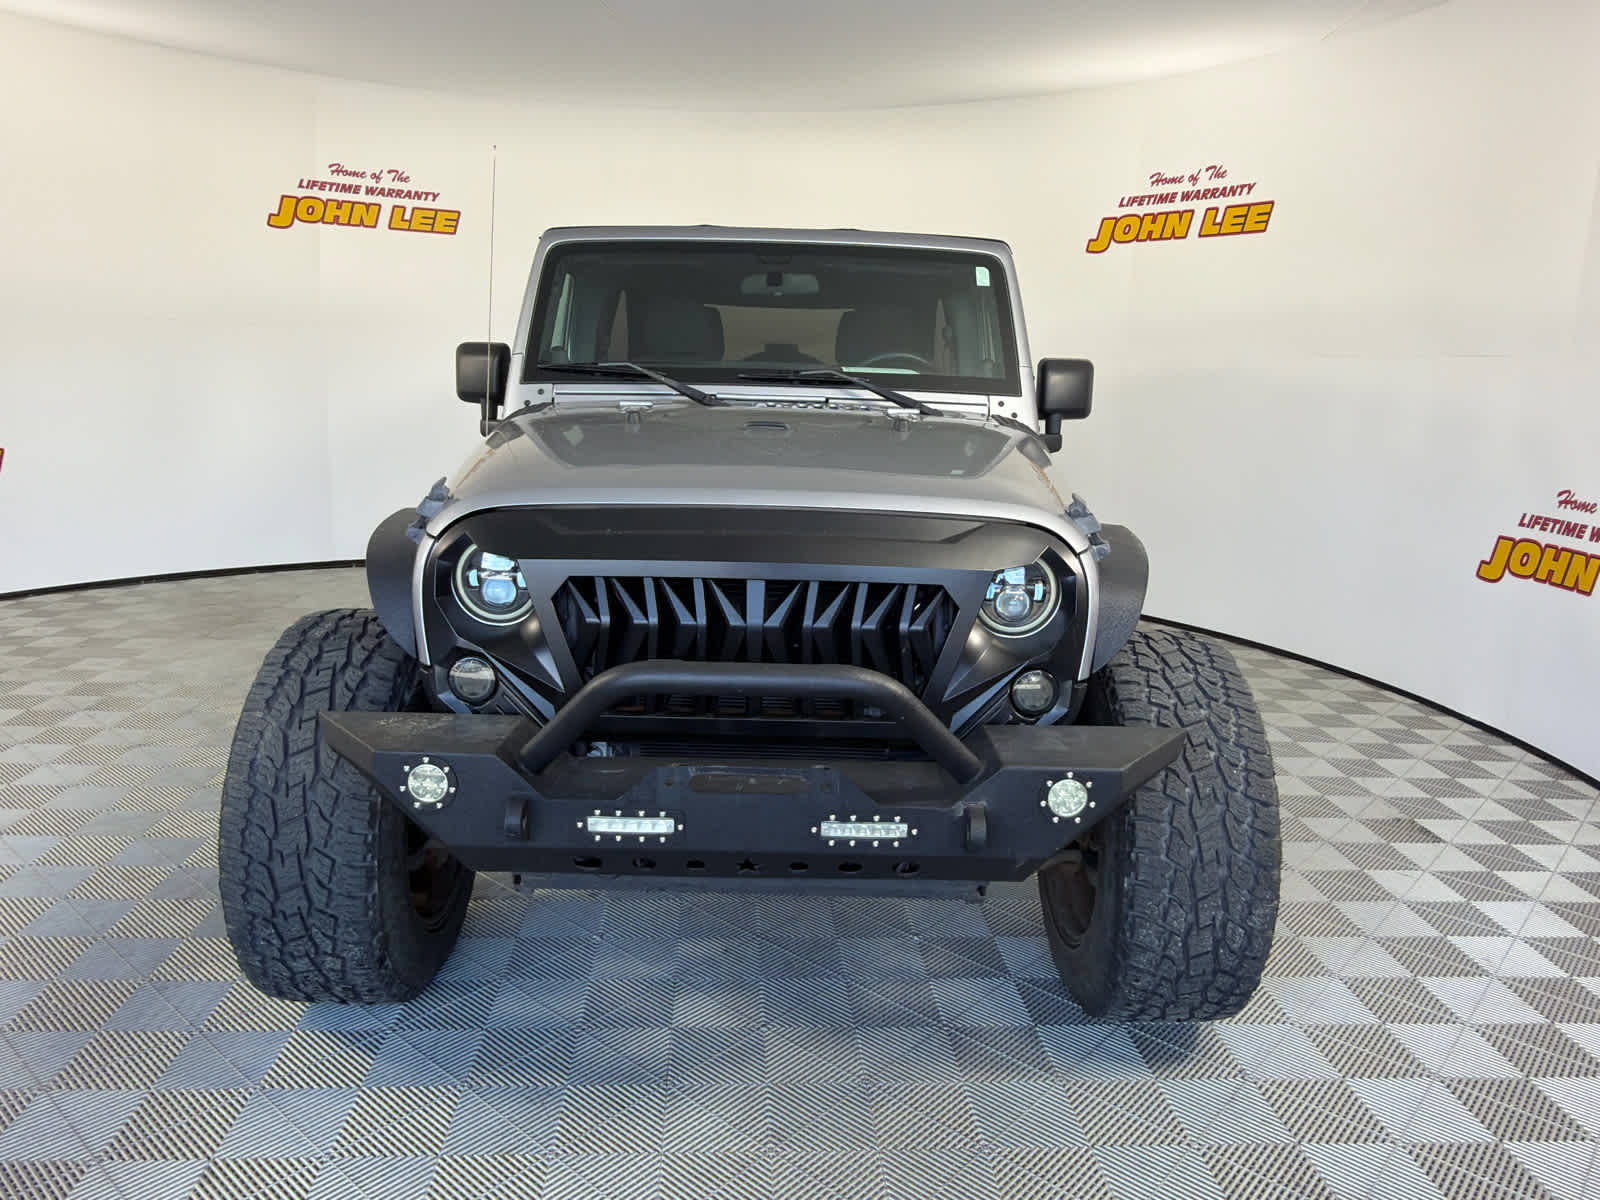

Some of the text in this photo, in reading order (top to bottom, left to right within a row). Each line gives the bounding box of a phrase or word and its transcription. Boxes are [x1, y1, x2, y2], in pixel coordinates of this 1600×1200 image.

[328, 163, 410, 184] Home of The
[1149, 165, 1227, 187] Home of The
[297, 178, 440, 202] LIFETIME WARRANTY
[1118, 182, 1256, 208] LIFETIME WARRANTY
[267, 195, 461, 235] JOHN LEE
[1086, 200, 1275, 253] JOHN LEE
[1557, 489, 1598, 514] Home
[1518, 512, 1588, 539] LIFETIME
[1476, 535, 1600, 597] JOHN
